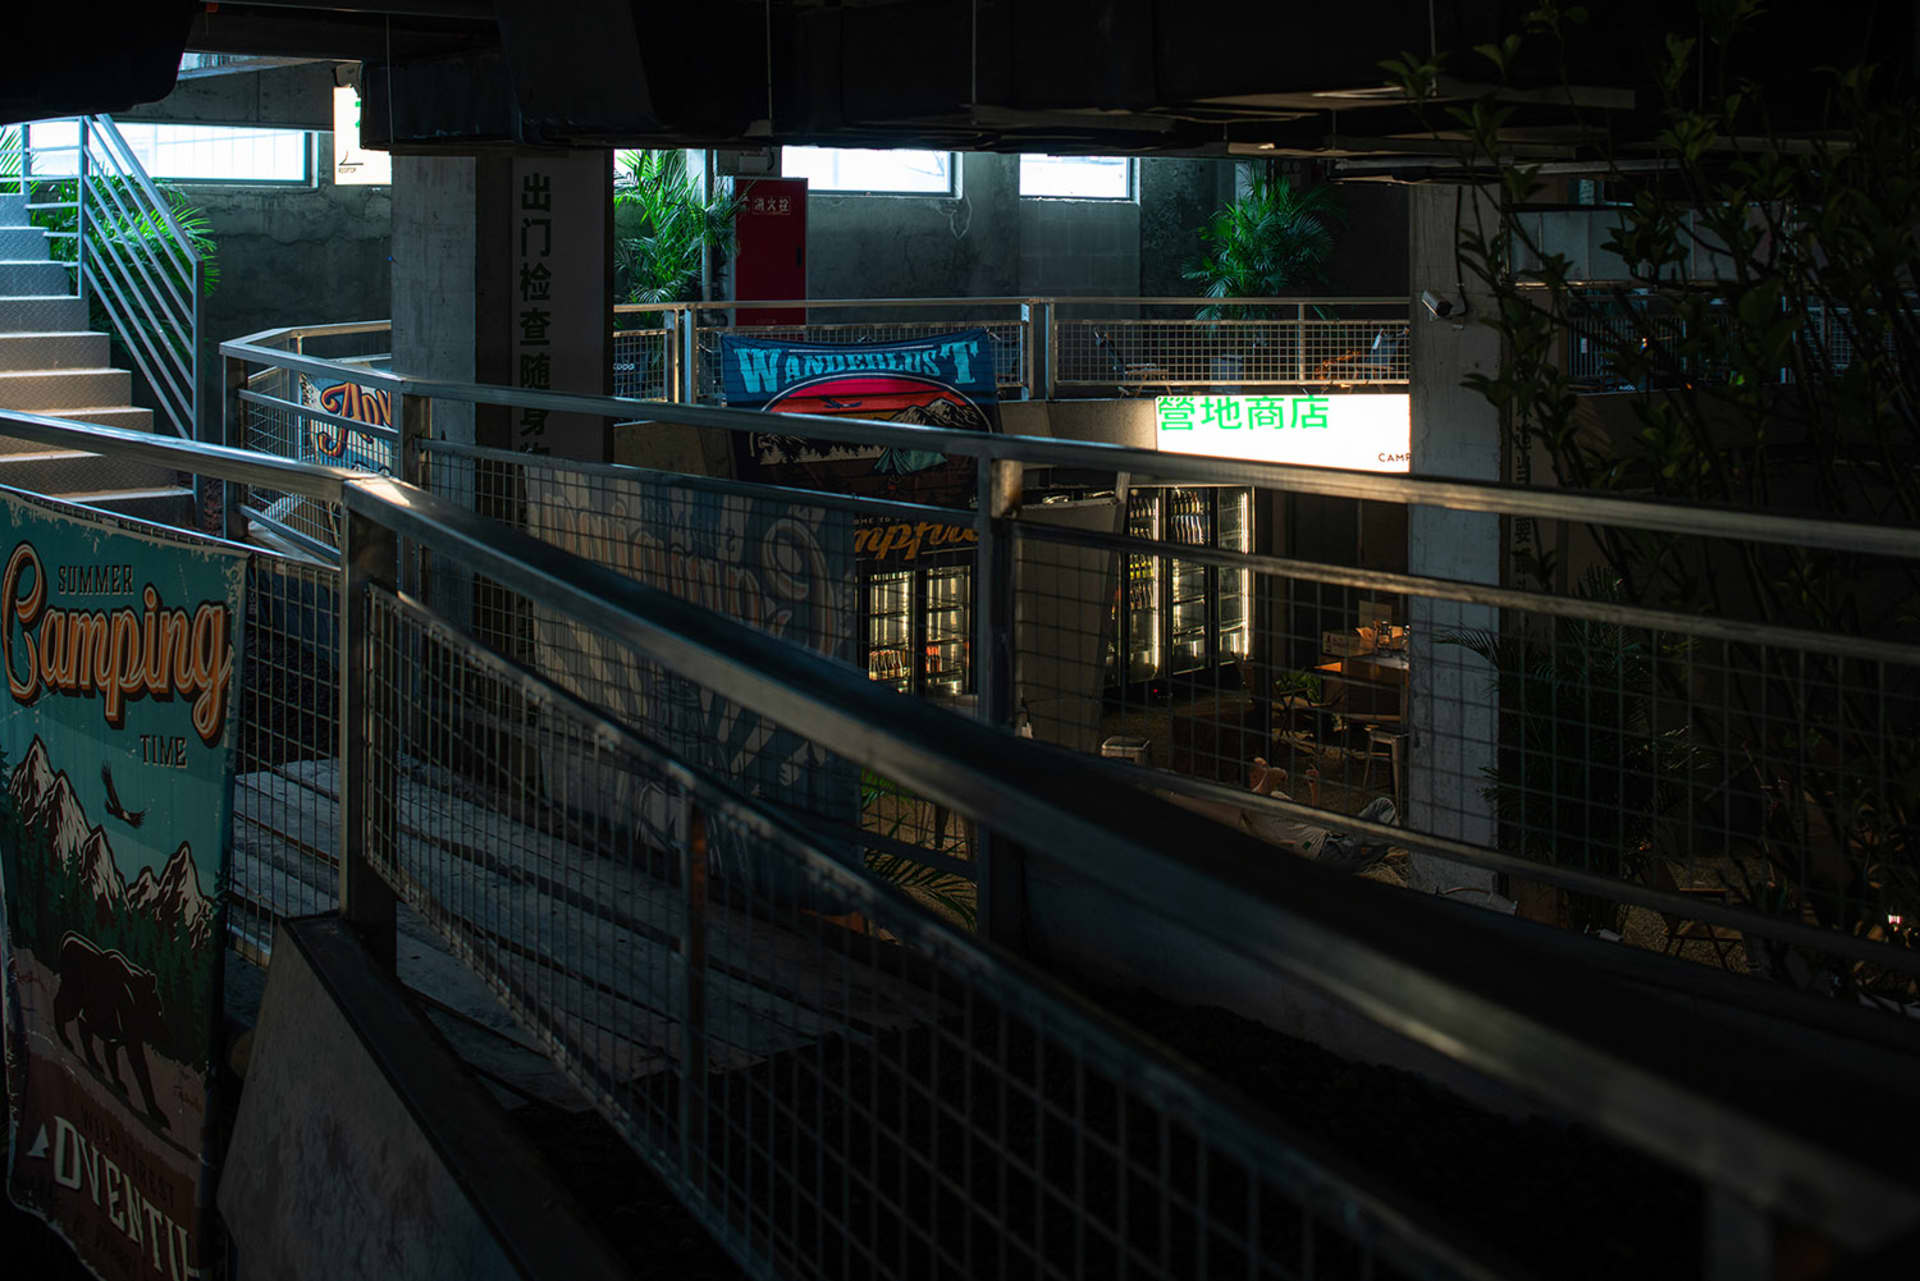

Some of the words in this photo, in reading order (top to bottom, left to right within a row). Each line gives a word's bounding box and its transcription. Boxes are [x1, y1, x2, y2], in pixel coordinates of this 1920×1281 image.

[520, 173, 551, 453] 出门检查随身
[733, 341, 978, 393] WANDERLUST
[1158, 396, 1329, 431] 營地商店
[58, 565, 135, 596] SUMMER
[3, 540, 233, 748] Camping
[140, 735, 188, 769] TIME
